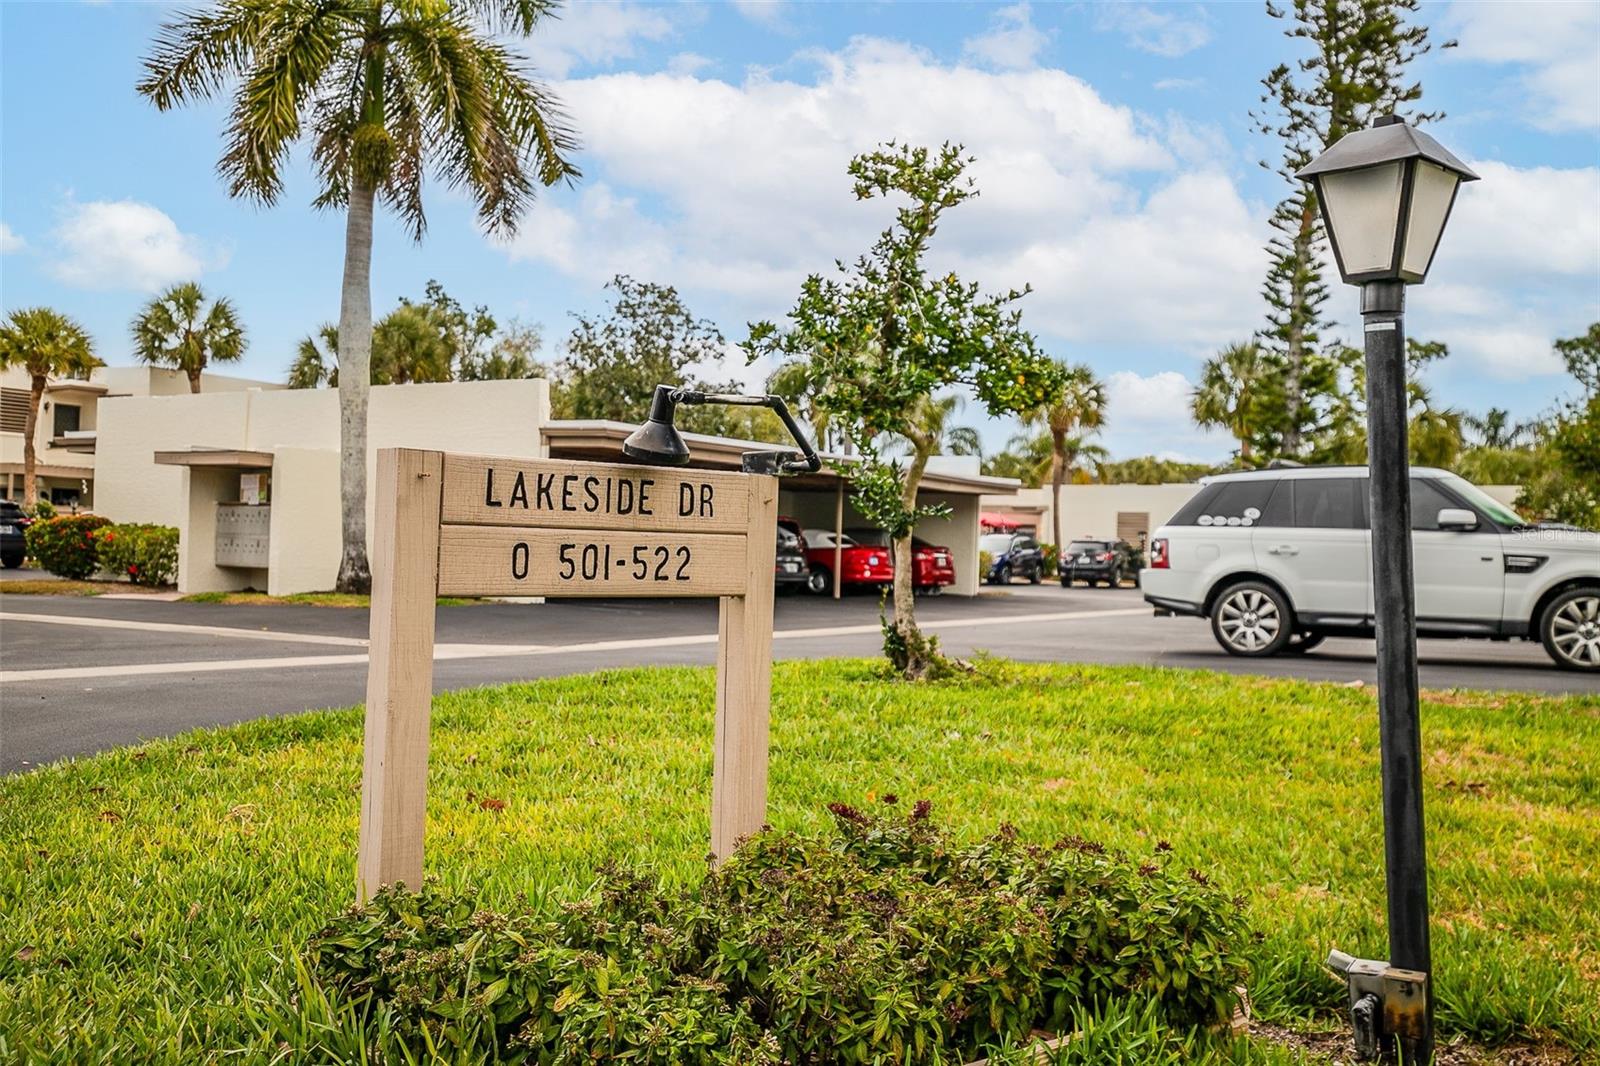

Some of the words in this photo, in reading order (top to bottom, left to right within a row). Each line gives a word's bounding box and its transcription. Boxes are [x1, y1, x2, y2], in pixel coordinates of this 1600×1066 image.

[485, 468, 655, 515] LAKESIDE
[679, 482, 714, 517] DR
[559, 543, 691, 581] 501-522
